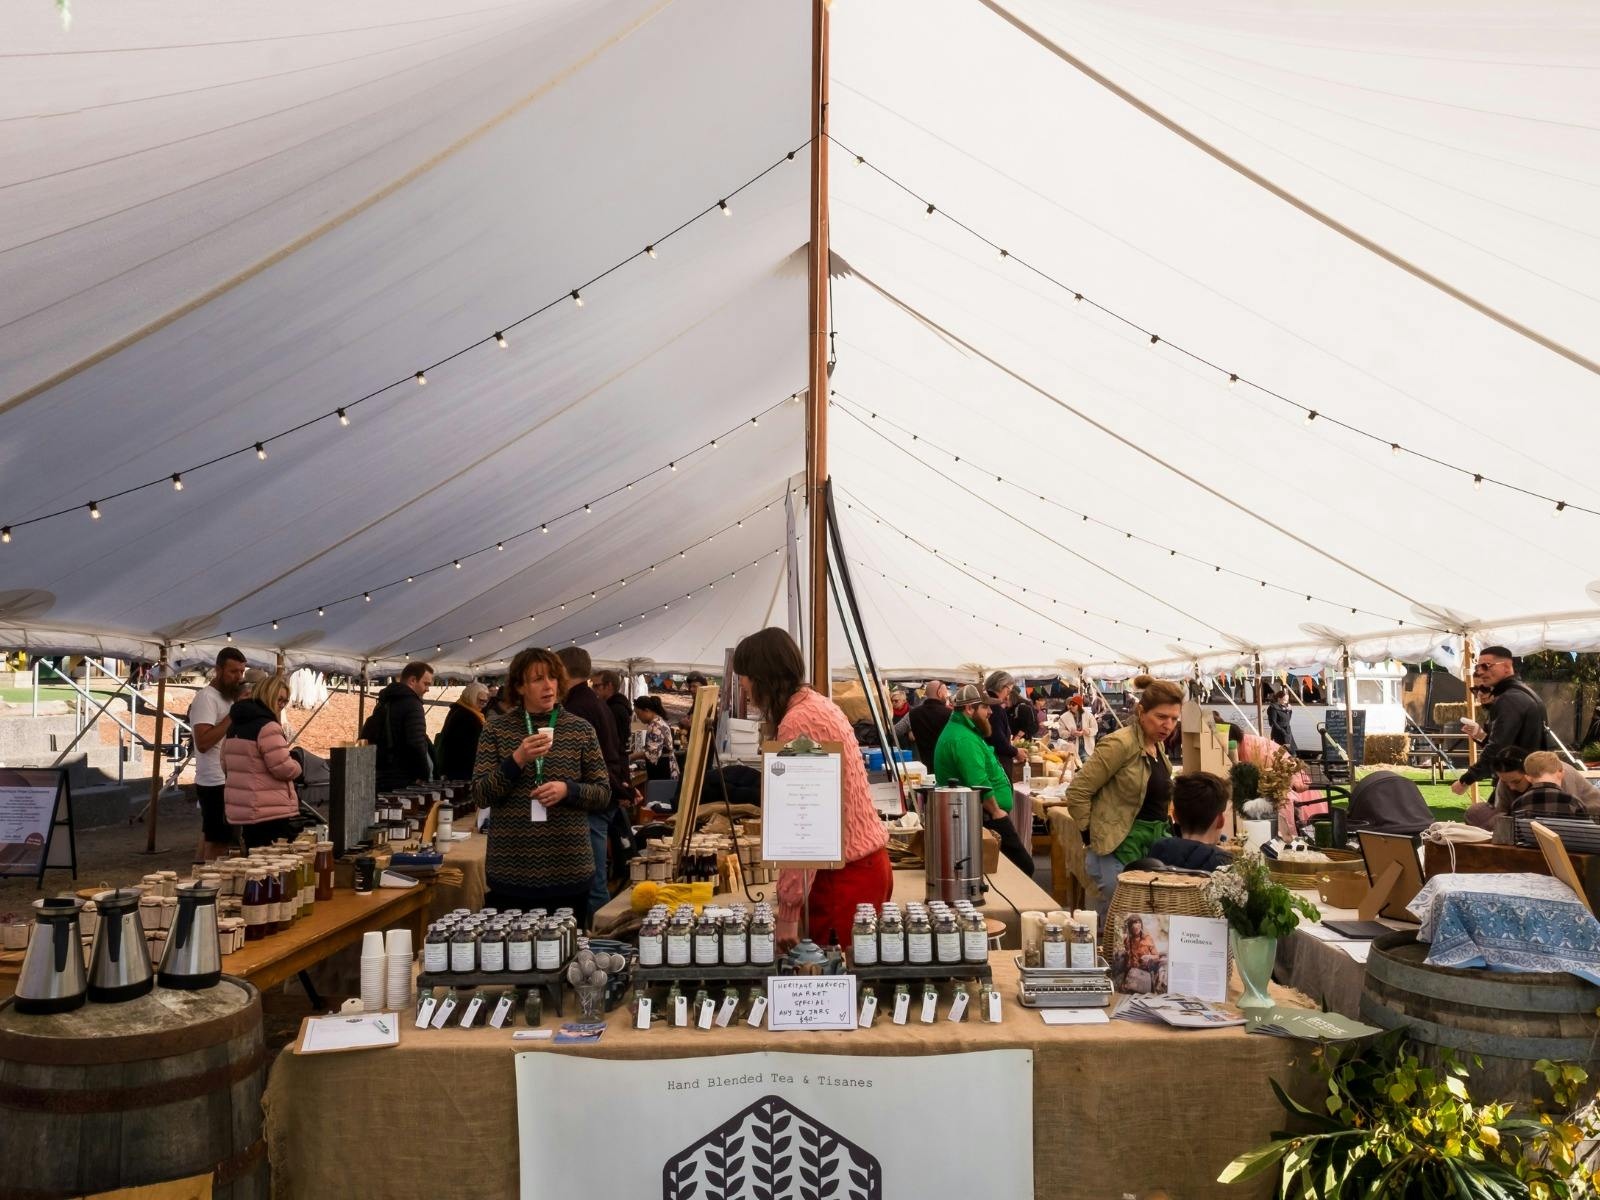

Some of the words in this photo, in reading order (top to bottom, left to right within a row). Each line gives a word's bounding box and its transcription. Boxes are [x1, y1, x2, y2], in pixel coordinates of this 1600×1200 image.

[778, 982, 812, 990] HERITAGE
[667, 1079, 700, 1091] Hand
[707, 1073, 763, 1088] Blended
[770, 1073, 794, 1084] Tea
[803, 1074, 810, 1084] &
[817, 1075, 873, 1088] Tisanes
